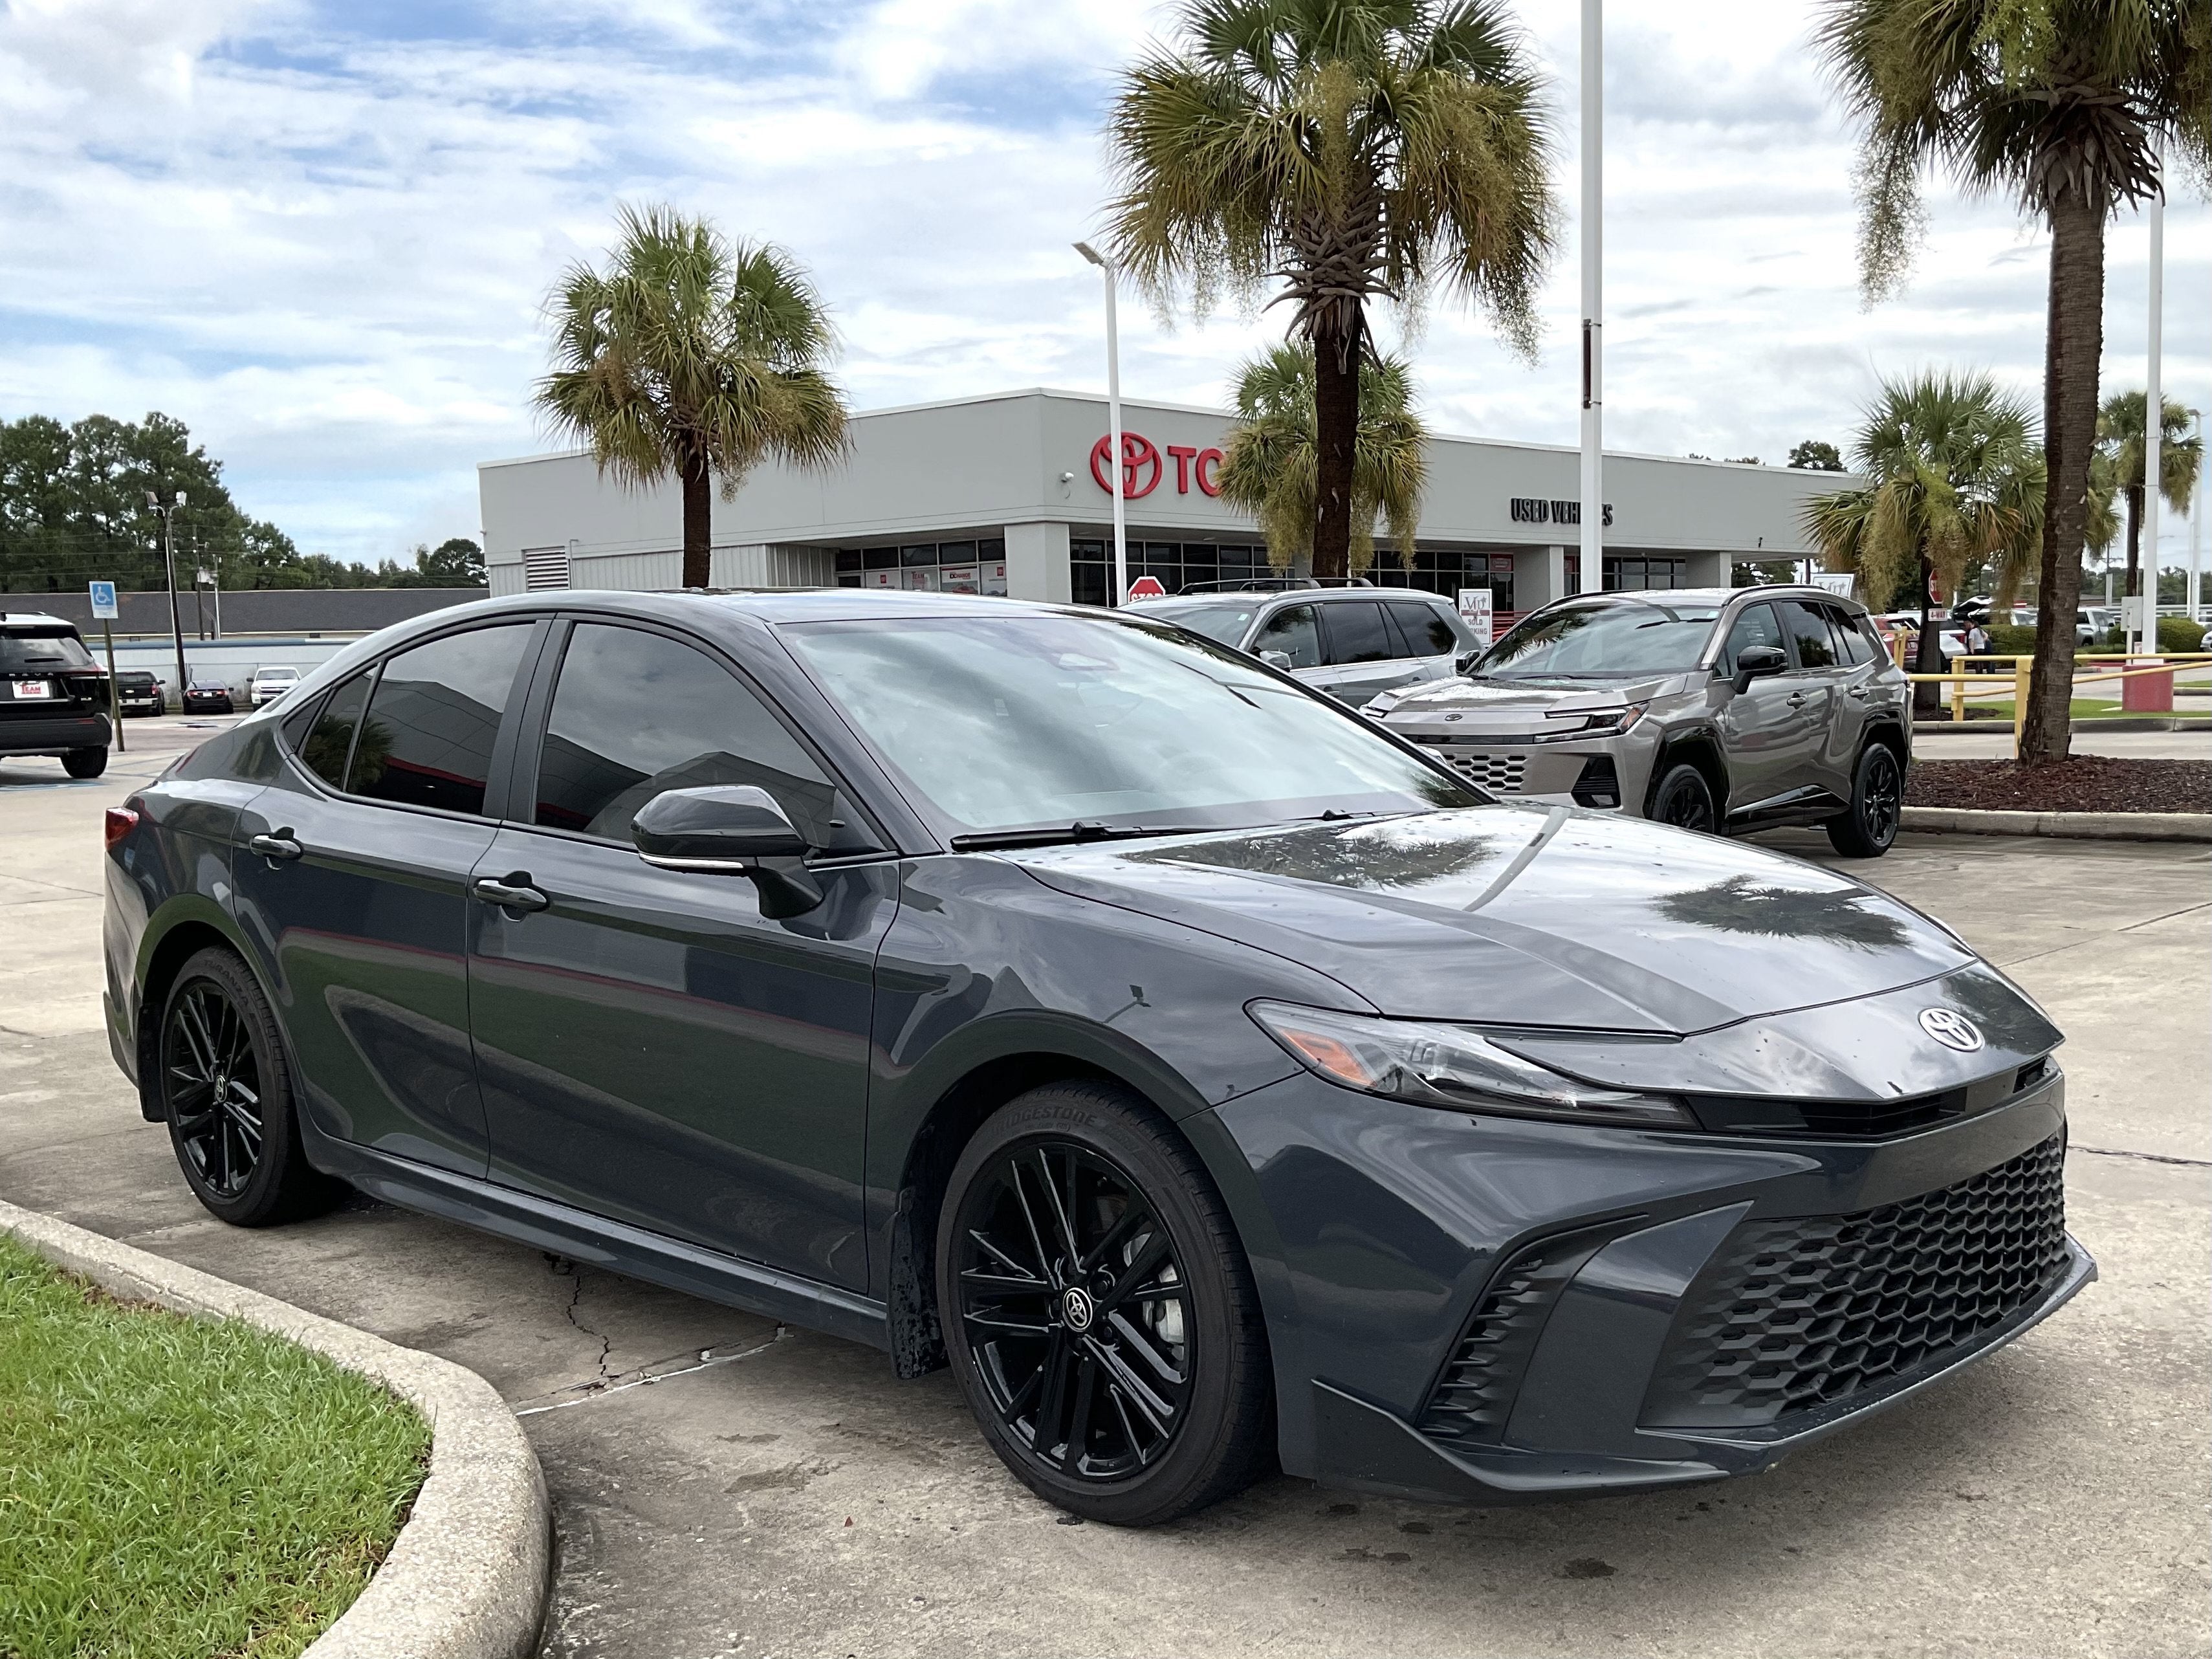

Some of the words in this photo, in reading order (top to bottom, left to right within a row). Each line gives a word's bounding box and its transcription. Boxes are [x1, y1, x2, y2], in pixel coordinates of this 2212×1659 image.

[1511, 498, 1549, 522] USED
[1550, 500, 1613, 526] VEHS
[1930, 610, 1946, 619] 4-WAY
